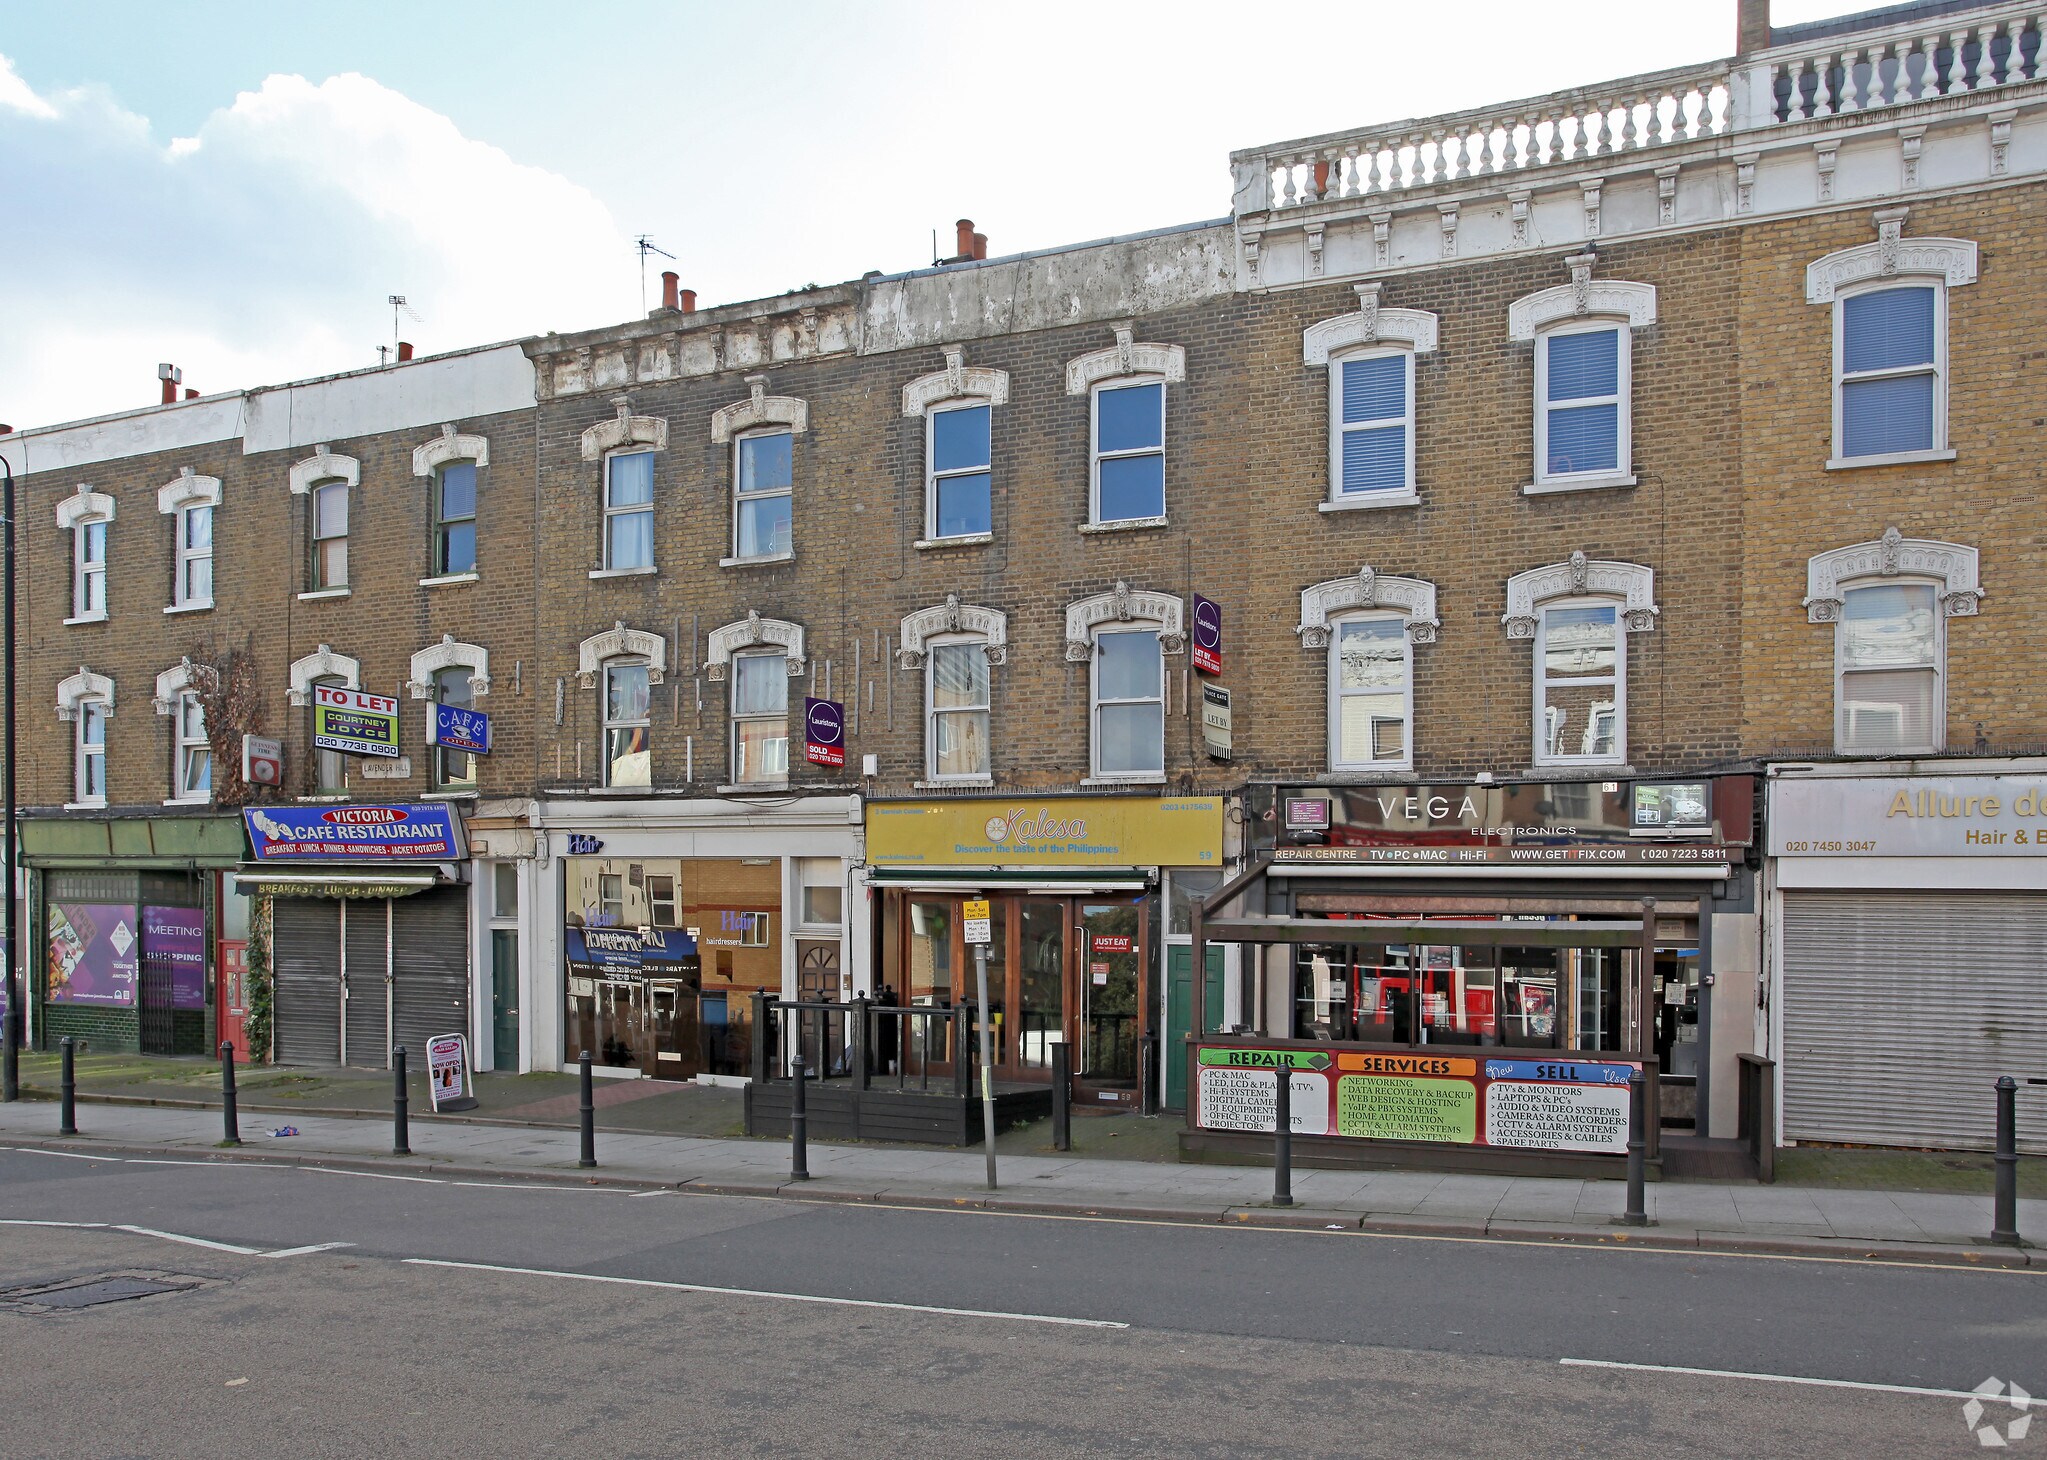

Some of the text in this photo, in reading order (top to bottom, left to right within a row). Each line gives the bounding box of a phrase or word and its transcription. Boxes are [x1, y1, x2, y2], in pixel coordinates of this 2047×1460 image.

[1198, 617, 1217, 632] Lauristons
[1195, 648, 1211, 660] LET BY
[318, 689, 395, 712] TO LET
[328, 714, 387, 727] COURTNEY
[439, 711, 484, 737] CAFÉ
[812, 717, 838, 728] Lauristons
[1208, 714, 1227, 727] LET BY
[328, 724, 387, 739] JOYCE
[317, 737, 397, 755] 020 7738 0900
[446, 738, 479, 748] OPEN
[810, 746, 827, 755] SOLD
[364, 764, 408, 772] LAVENDER HILL
[1378, 796, 1478, 819] VEGA
[1887, 789, 2000, 818] Allure
[333, 810, 395, 823] VICTORIA
[295, 822, 444, 840] CAFÉ RESTAURANT
[1006, 808, 1088, 845] Kalesa
[1472, 826, 1576, 836] ELECTRONICS
[567, 833, 599, 853] Hair
[1966, 829, 2029, 845] Hair &
[266, 843, 445, 855] BREAKFAST LUNCH DINNER JACKET POTATOES
[955, 844, 1119, 855] Discover the taste of the Philippines
[1786, 841, 1876, 852] 020 7450 3047
[1200, 852, 1212, 860] 59
[1275, 850, 1727, 860] REPAIR CENTRE TV PC MAC Hi-Fi WWW.GETITFIX.COM 020 7223 5811
[258, 884, 315, 894] BREAKFAST
[324, 886, 359, 895] LUNCH
[585, 908, 619, 927] Hair
[721, 911, 756, 931] Hair
[149, 925, 202, 937] MEETING
[706, 938, 742, 946] hairdressers
[1095, 938, 1129, 946] JUST EAT
[1229, 1052, 1295, 1066] REPAIR
[1364, 1057, 1450, 1074] SERVICES
[1230, 1072, 1251, 1080] MAC
[1486, 1064, 1514, 1080] New
[1537, 1065, 1579, 1080] SELL
[1209, 1079, 1314, 1091] LED, LCD & PLAA TV's
[1348, 1078, 1413, 1087] NETWORKING
[1230, 1088, 1269, 1097] SYSTEMS
[1348, 1086, 1373, 1094] DATA
[1375, 1088, 1425, 1097] RECOVERY
[1437, 1090, 1474, 1099] BACKUP
[1497, 1084, 1582, 1096] TV's & MONITORS
[1210, 1096, 1245, 1105] DIGITAL
[1348, 1095, 1369, 1103] WEB
[1371, 1096, 1405, 1104] DESIGN
[1417, 1098, 1461, 1108] HOSTING
[1497, 1094, 1571, 1104] LAPTOPS & PC's
[1210, 1104, 1219, 1112] DJ
[1368, 1104, 1376, 1112] &
[1378, 1105, 1395, 1113] PBX
[1397, 1106, 1438, 1115] SYSTEMS
[1497, 1103, 1621, 1116] AUDIO & VIDEO SYSTEMS
[1210, 1112, 1240, 1121] OFFICE
[1348, 1112, 1444, 1124] HOME AUTOMATION
[1497, 1111, 1627, 1126] CAMERAS & CAMCORDERS
[1210, 1121, 1264, 1130] PROJECTORS
[1348, 1120, 1373, 1128] CCTV
[1384, 1122, 1417, 1131] ALARM
[1420, 1124, 1461, 1134] SYSTEMS
[1497, 1120, 1618, 1134] CCTV & ALARM SYSTEMS
[1348, 1129, 1452, 1141] DOOR ENTRY SYSTEMS
[1497, 1129, 1613, 1143] ACCESSORIES & CABLES
[1497, 1138, 1559, 1148] SPARE PARTS
